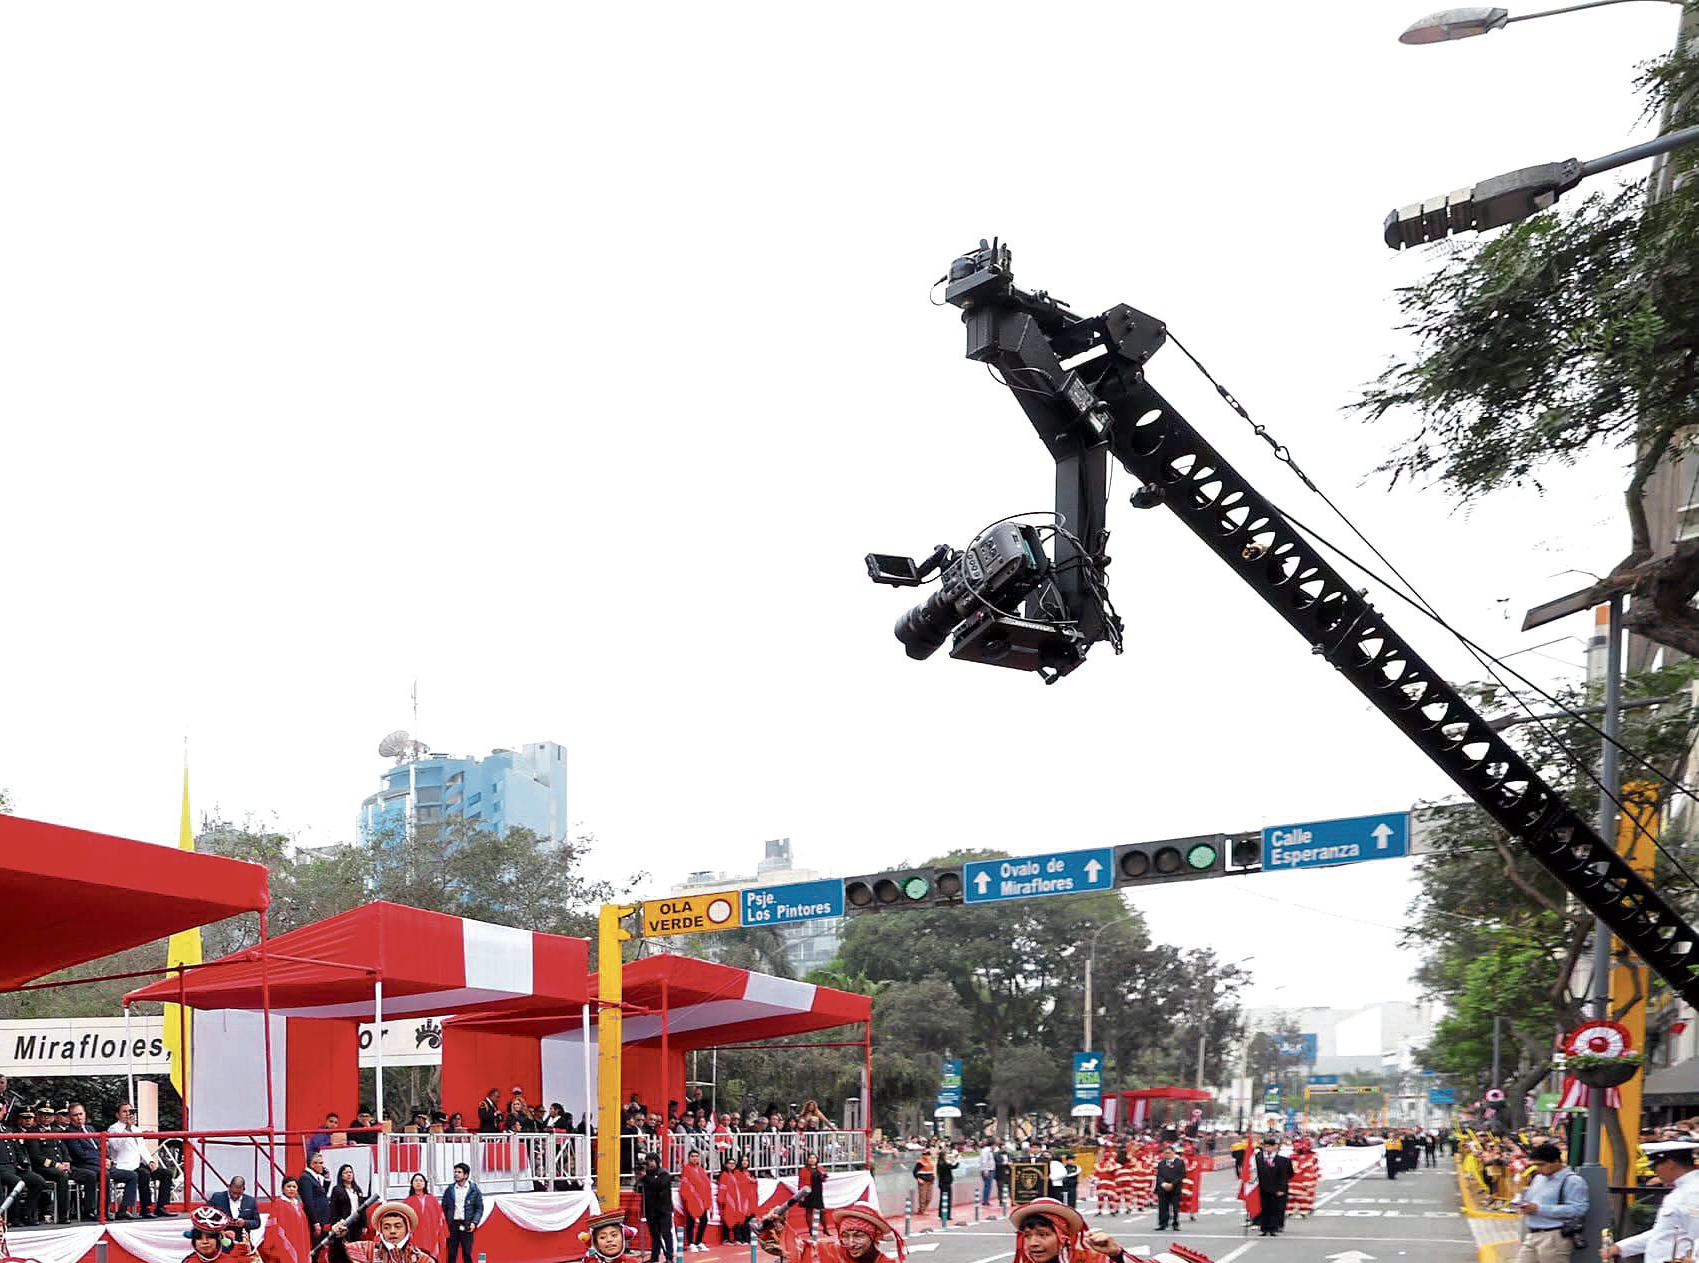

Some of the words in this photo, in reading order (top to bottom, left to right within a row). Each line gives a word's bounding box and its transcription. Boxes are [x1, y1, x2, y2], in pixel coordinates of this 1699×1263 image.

[1271, 828, 1312, 847] Calle
[1271, 844, 1360, 866] Esperanza
[1000, 861, 1040, 878] Ovalo
[1047, 858, 1065, 873] de
[1000, 877, 1074, 896] Miraflores
[660, 901, 693, 915] OLA
[747, 892, 777, 909] Psje.
[747, 908, 770, 922] Los
[777, 902, 831, 919] Pintores
[649, 916, 703, 931] VERDE
